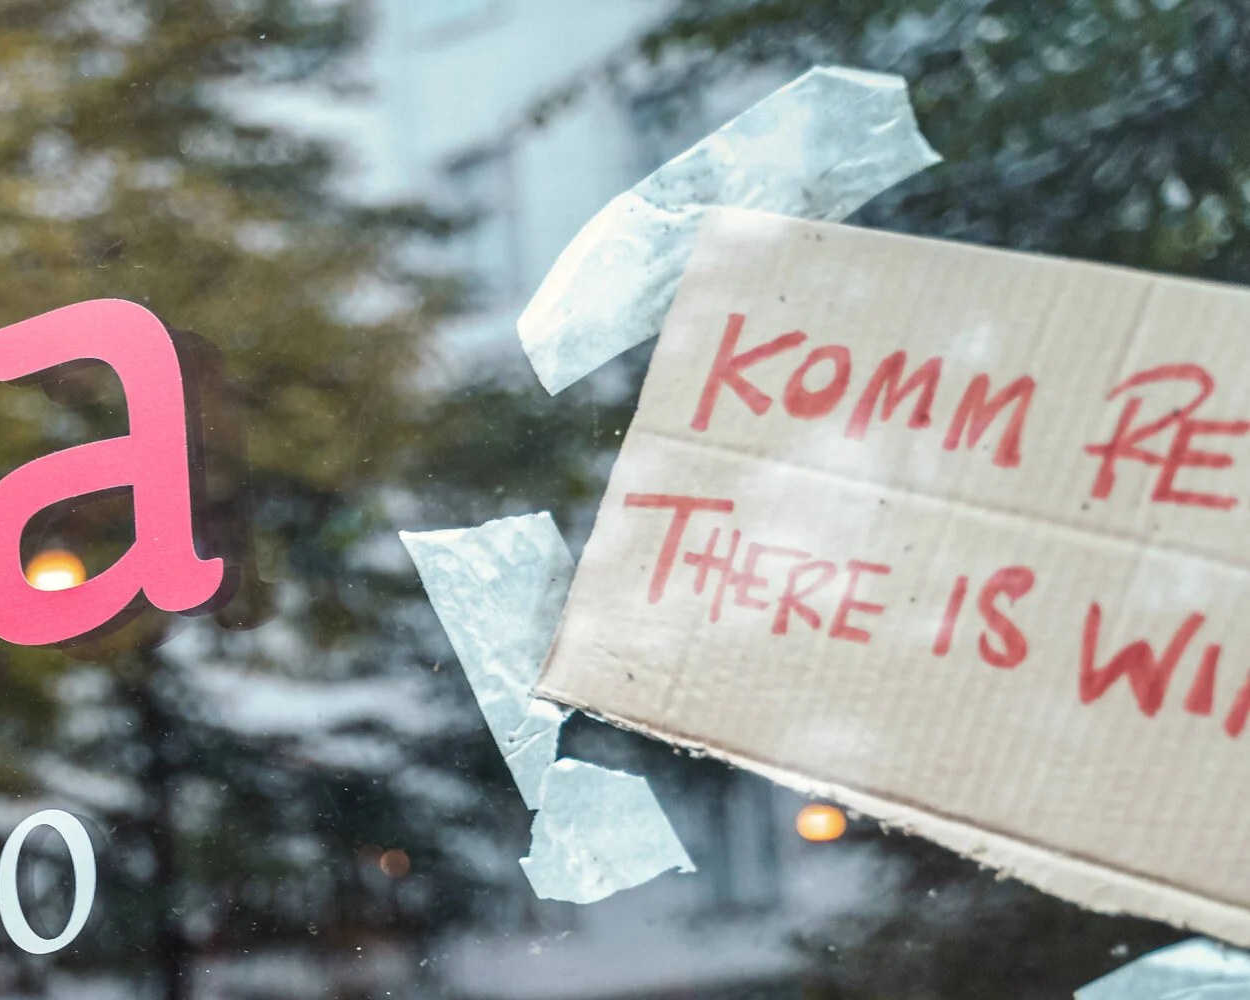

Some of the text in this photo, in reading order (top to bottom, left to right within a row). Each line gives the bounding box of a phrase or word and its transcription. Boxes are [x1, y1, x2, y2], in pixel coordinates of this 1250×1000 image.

[690, 313, 1036, 468] KOMM
[623, 493, 1250, 738] THERE IS WI
